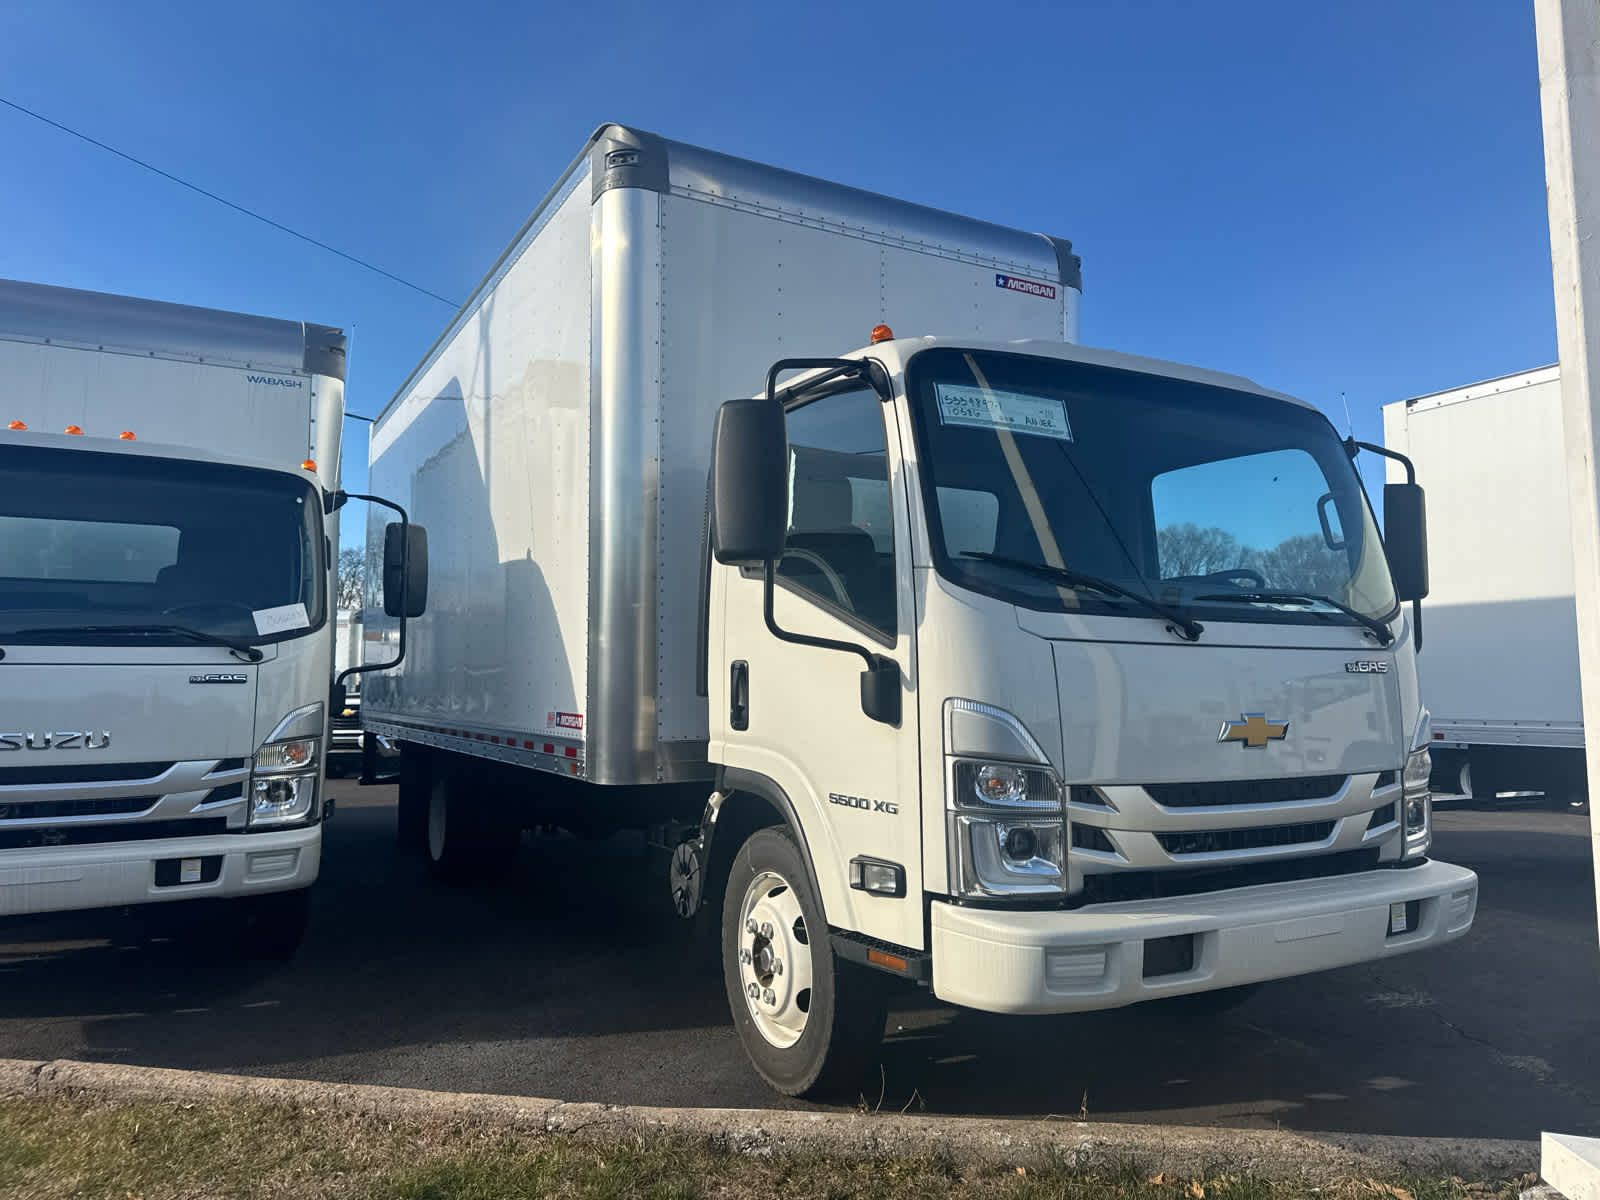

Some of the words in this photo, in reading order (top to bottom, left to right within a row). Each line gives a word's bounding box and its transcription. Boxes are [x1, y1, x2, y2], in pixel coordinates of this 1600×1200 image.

[1007, 279, 1055, 297] MORGAN
[247, 375, 303, 388] WABASH
[828, 792, 871, 810] 5500
[873, 800, 899, 815] XG
